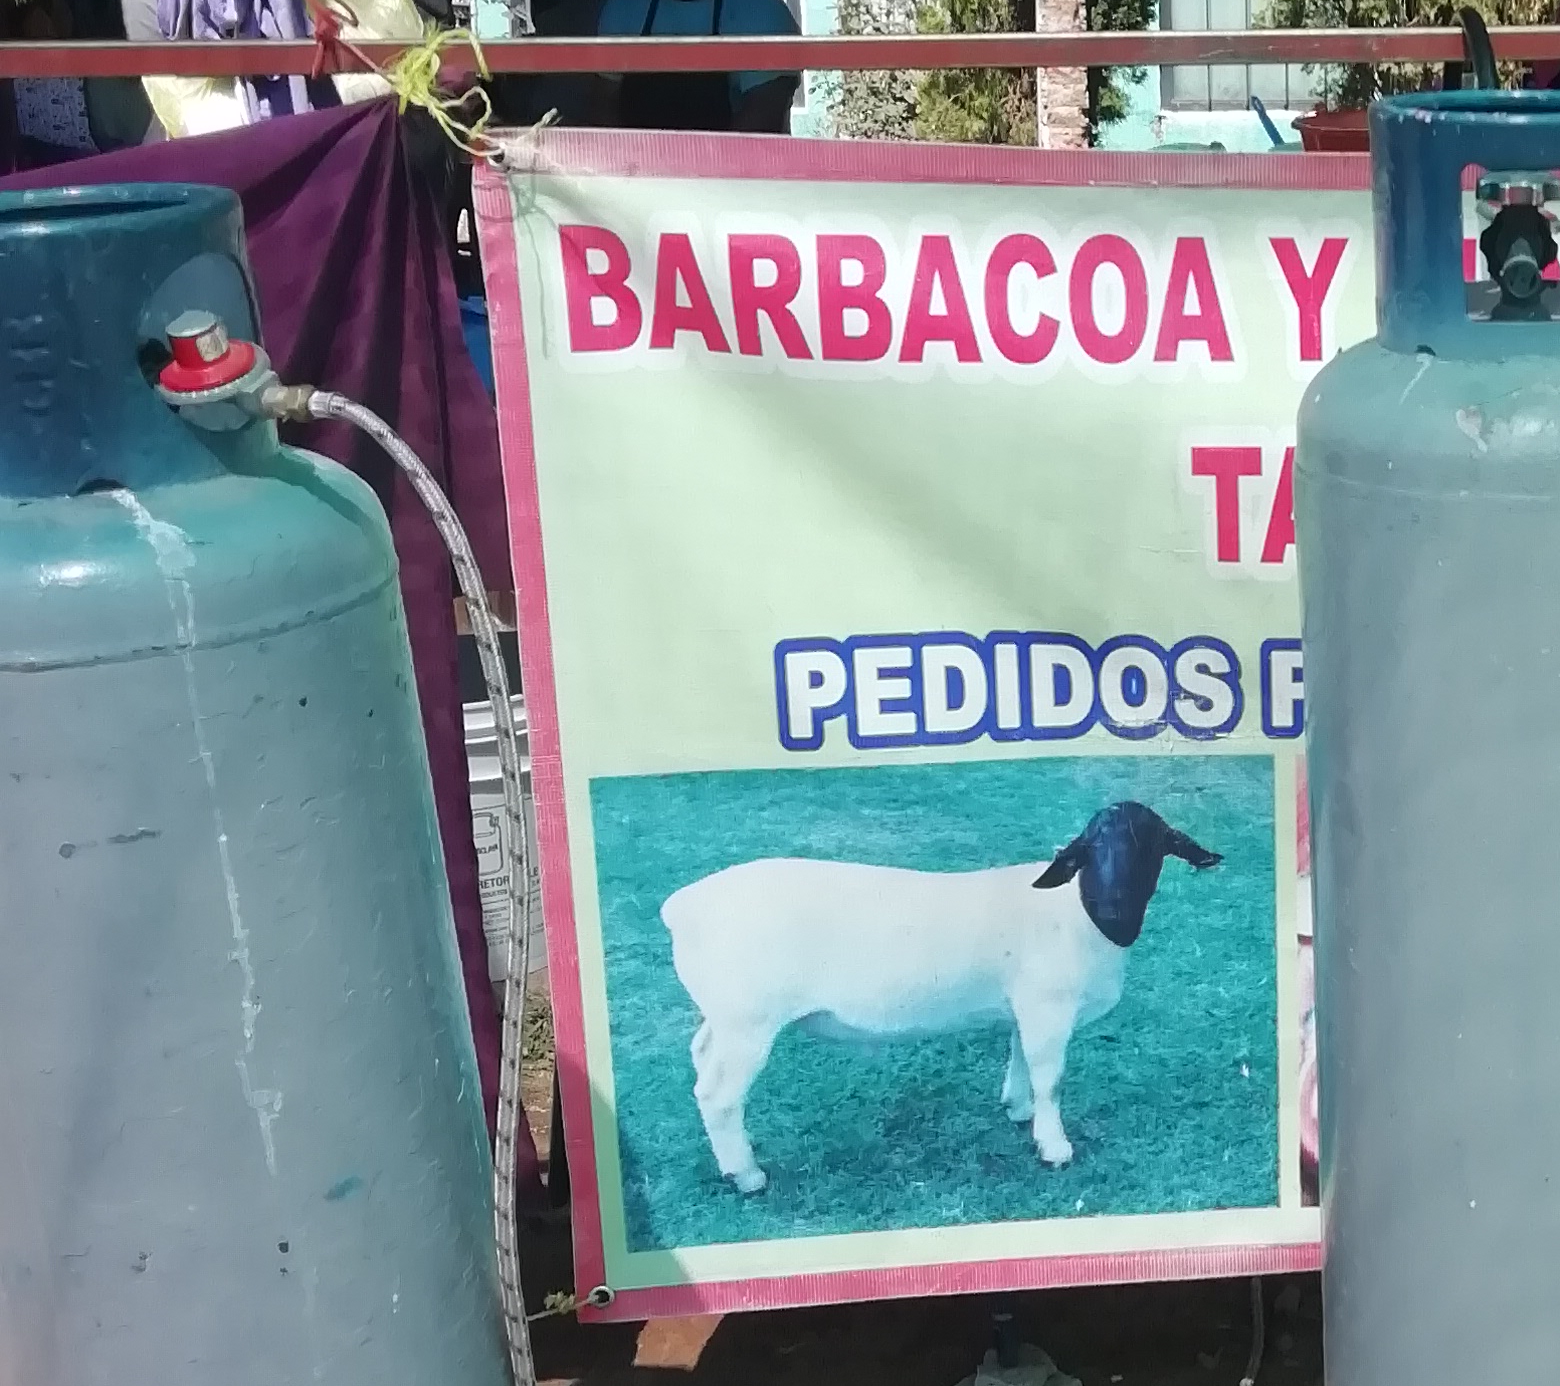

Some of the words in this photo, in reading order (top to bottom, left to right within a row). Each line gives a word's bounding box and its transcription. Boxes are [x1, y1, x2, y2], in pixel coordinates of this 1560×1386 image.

[559, 225, 1232, 364] BARBACOA
[1270, 237, 1348, 361] Y
[774, 629, 1243, 751] PEDIDOS
